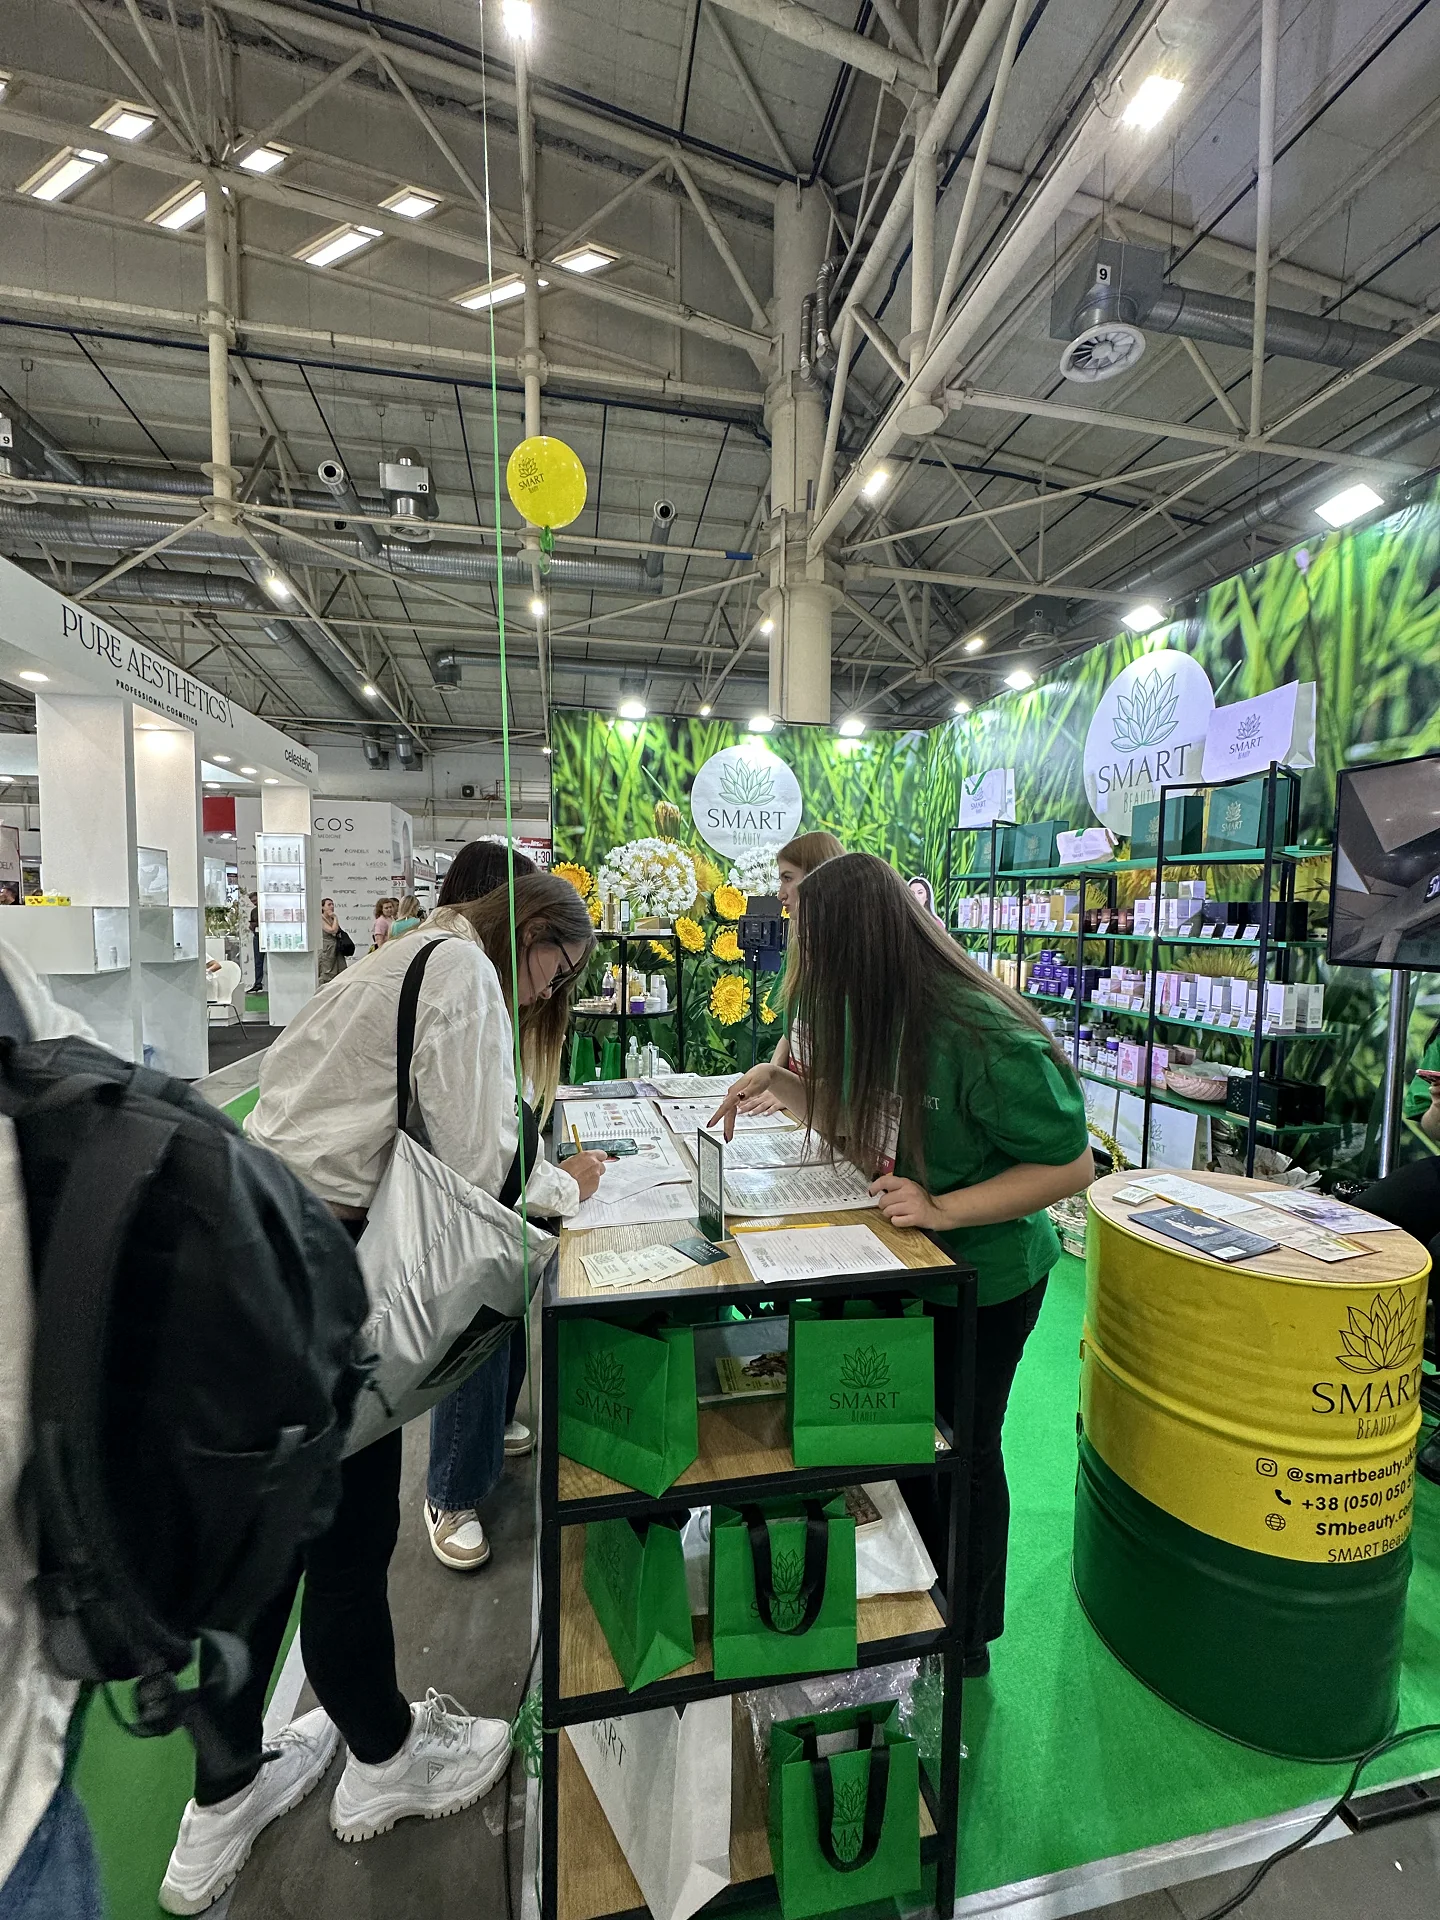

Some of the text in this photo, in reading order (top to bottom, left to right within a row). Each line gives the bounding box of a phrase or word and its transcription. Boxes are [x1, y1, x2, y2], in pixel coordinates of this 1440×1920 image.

[1099, 268, 1108, 280] 9
[3, 436, 10, 444] 9
[417, 484, 428, 492] 10
[518, 473, 545, 490] SMART
[62, 604, 227, 724] PURE AESTHETICS
[116, 679, 198, 726] PROFESSIONAL COSMETICS
[1229, 736, 1263, 755] SMART
[1098, 743, 1192, 794] SMART
[971, 800, 986, 810] SMART
[314, 817, 354, 831] COS
[707, 808, 786, 830] SMART
[1221, 820, 1243, 832] SMART
[732, 831, 761, 846] BEAUTY
[922, 1095, 940, 1110] ART
[700, 1195, 721, 1223] SMART
[1312, 1364, 1421, 1414] SMART
[575, 1387, 635, 1425] SMART
[829, 1391, 900, 1410] SMART
[851, 1409, 878, 1422] BEAUTY
[1356, 1413, 1398, 1440] BEAUTY
[1302, 1497, 1339, 1511] +38
[1344, 1490, 1382, 1512] (050)
[1386, 1483, 1406, 1501] 050
[1328, 1541, 1379, 1563] SMART
[750, 1599, 809, 1619] SMAR
[597, 1719, 627, 1767] ART
